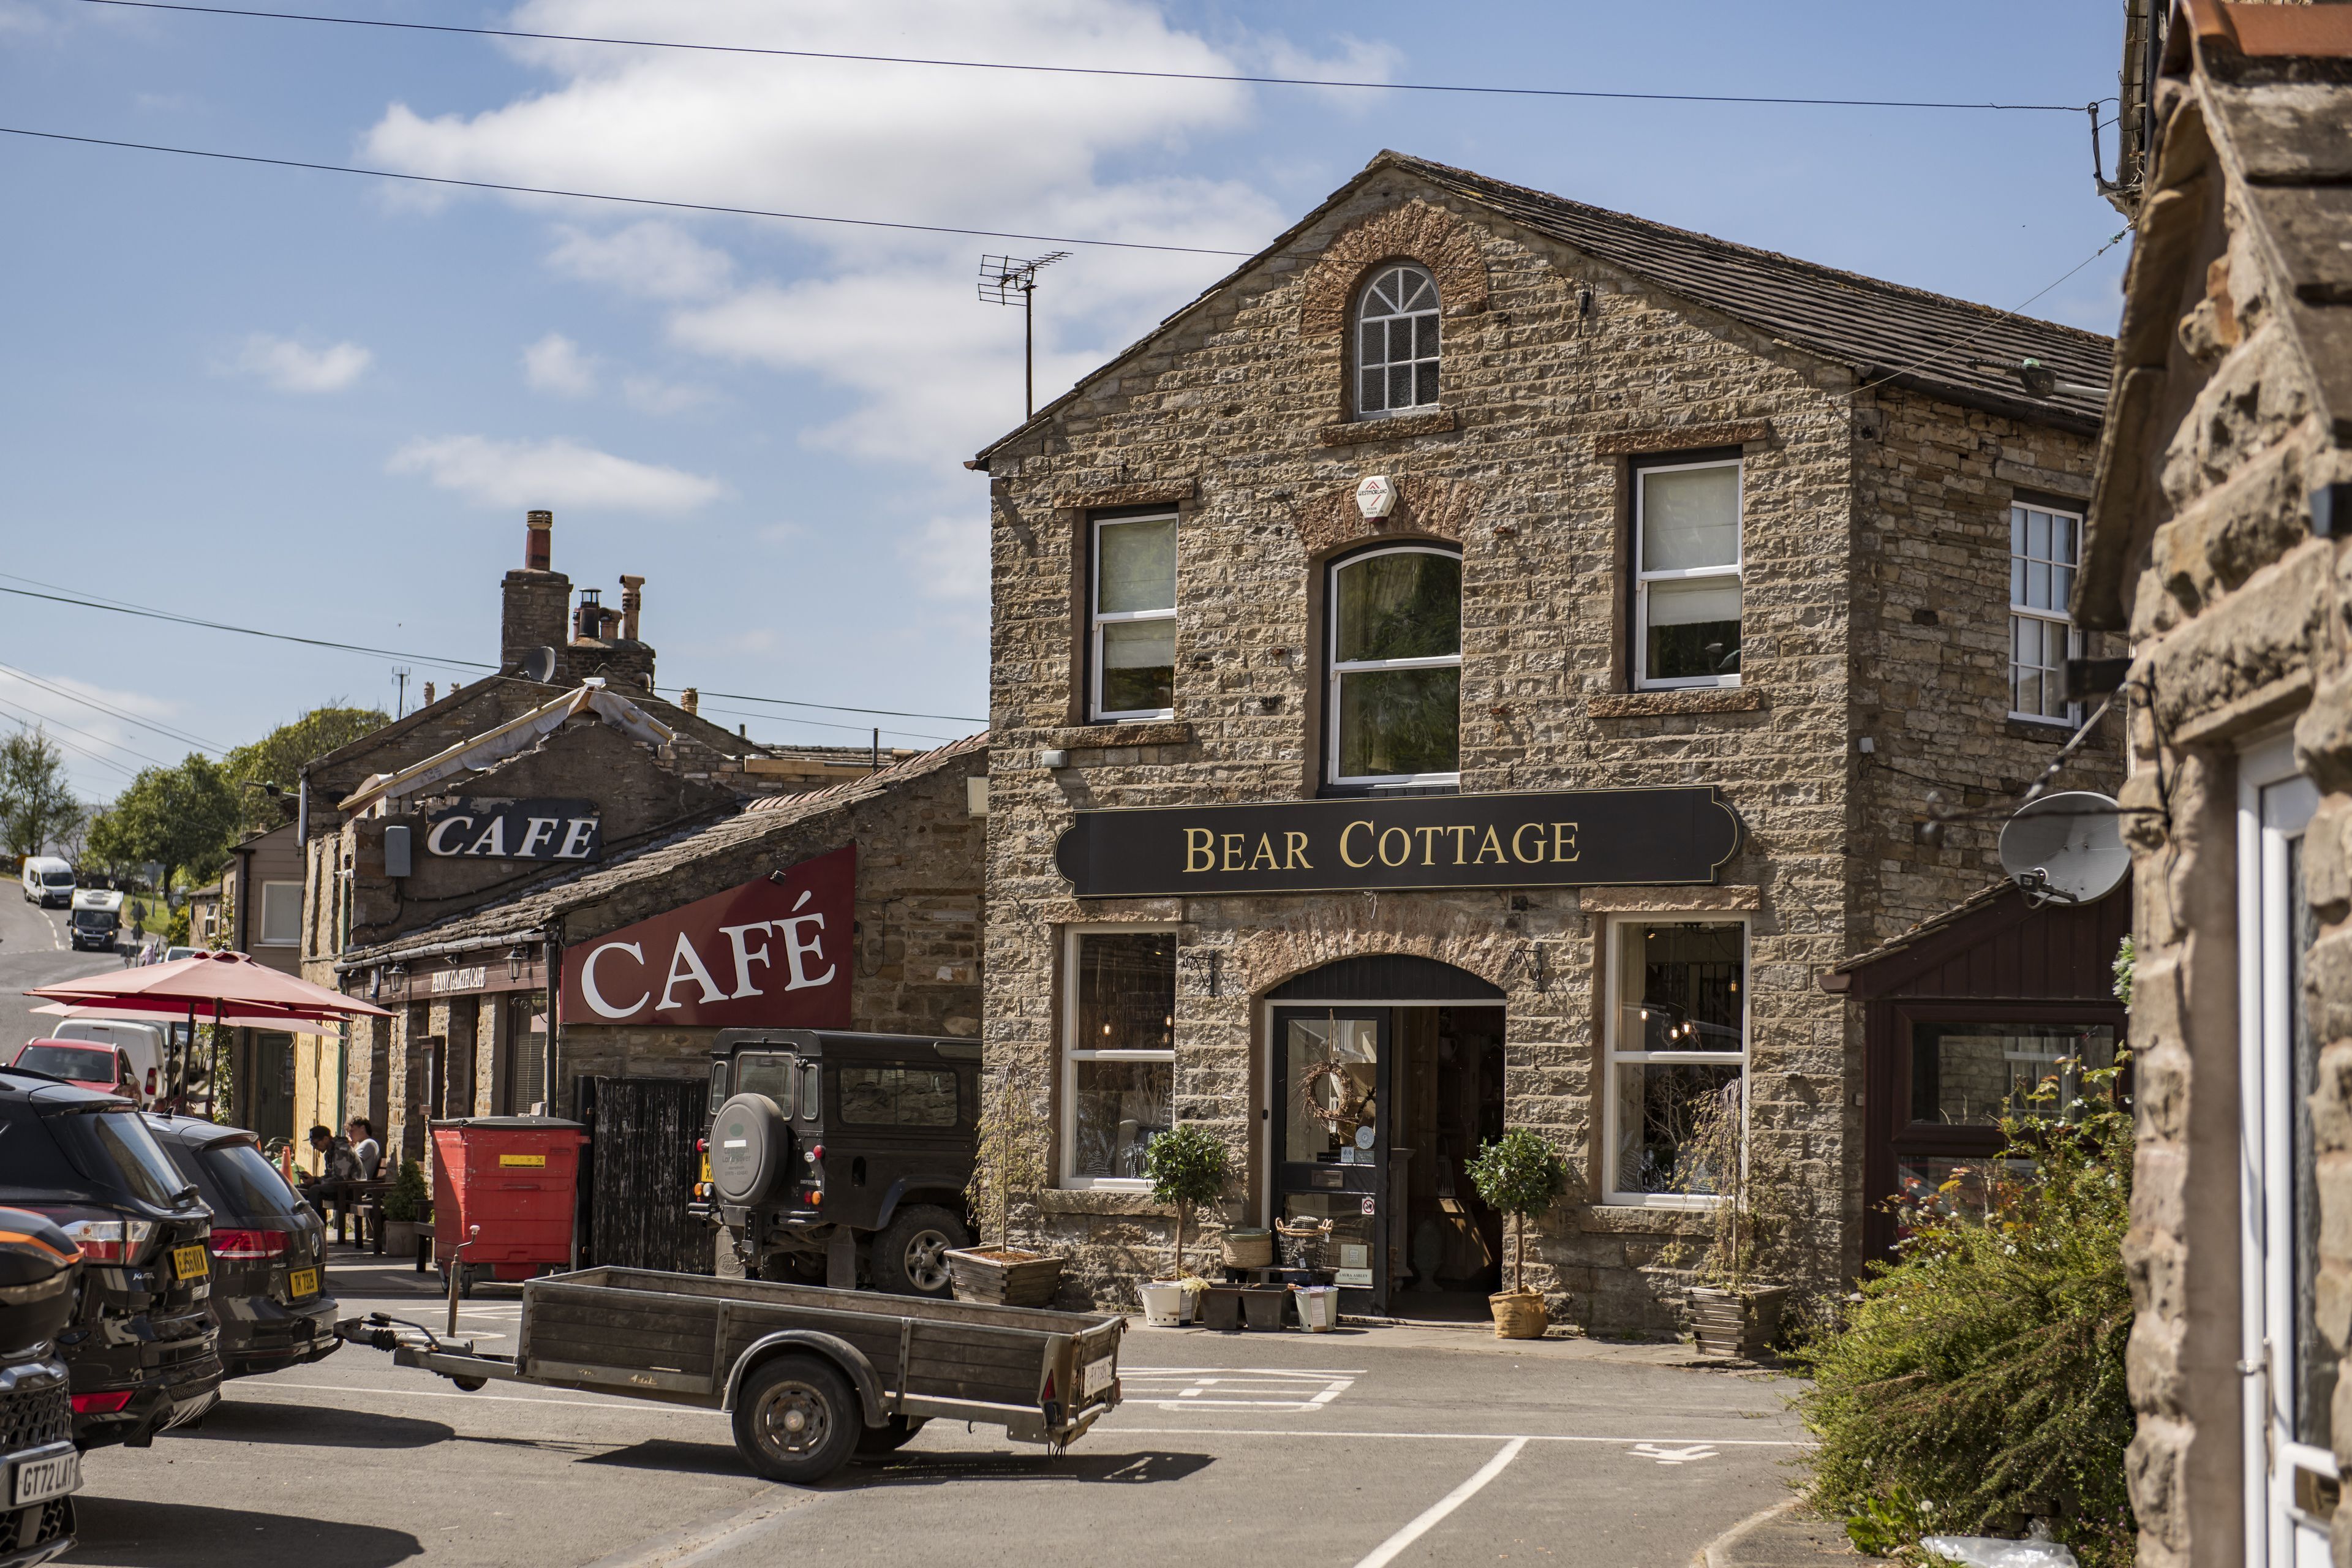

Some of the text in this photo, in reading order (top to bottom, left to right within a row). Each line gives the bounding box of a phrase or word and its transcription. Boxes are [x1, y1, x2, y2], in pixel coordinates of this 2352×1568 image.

[427, 816, 598, 859] CAFE
[1182, 820, 1581, 873] BEAR COTTAGE
[581, 890, 836, 1019] CAFÉ
[431, 967, 486, 992] PENNY GARTH CAFE
[23, 1457, 74, 1496] GT72 LAT
